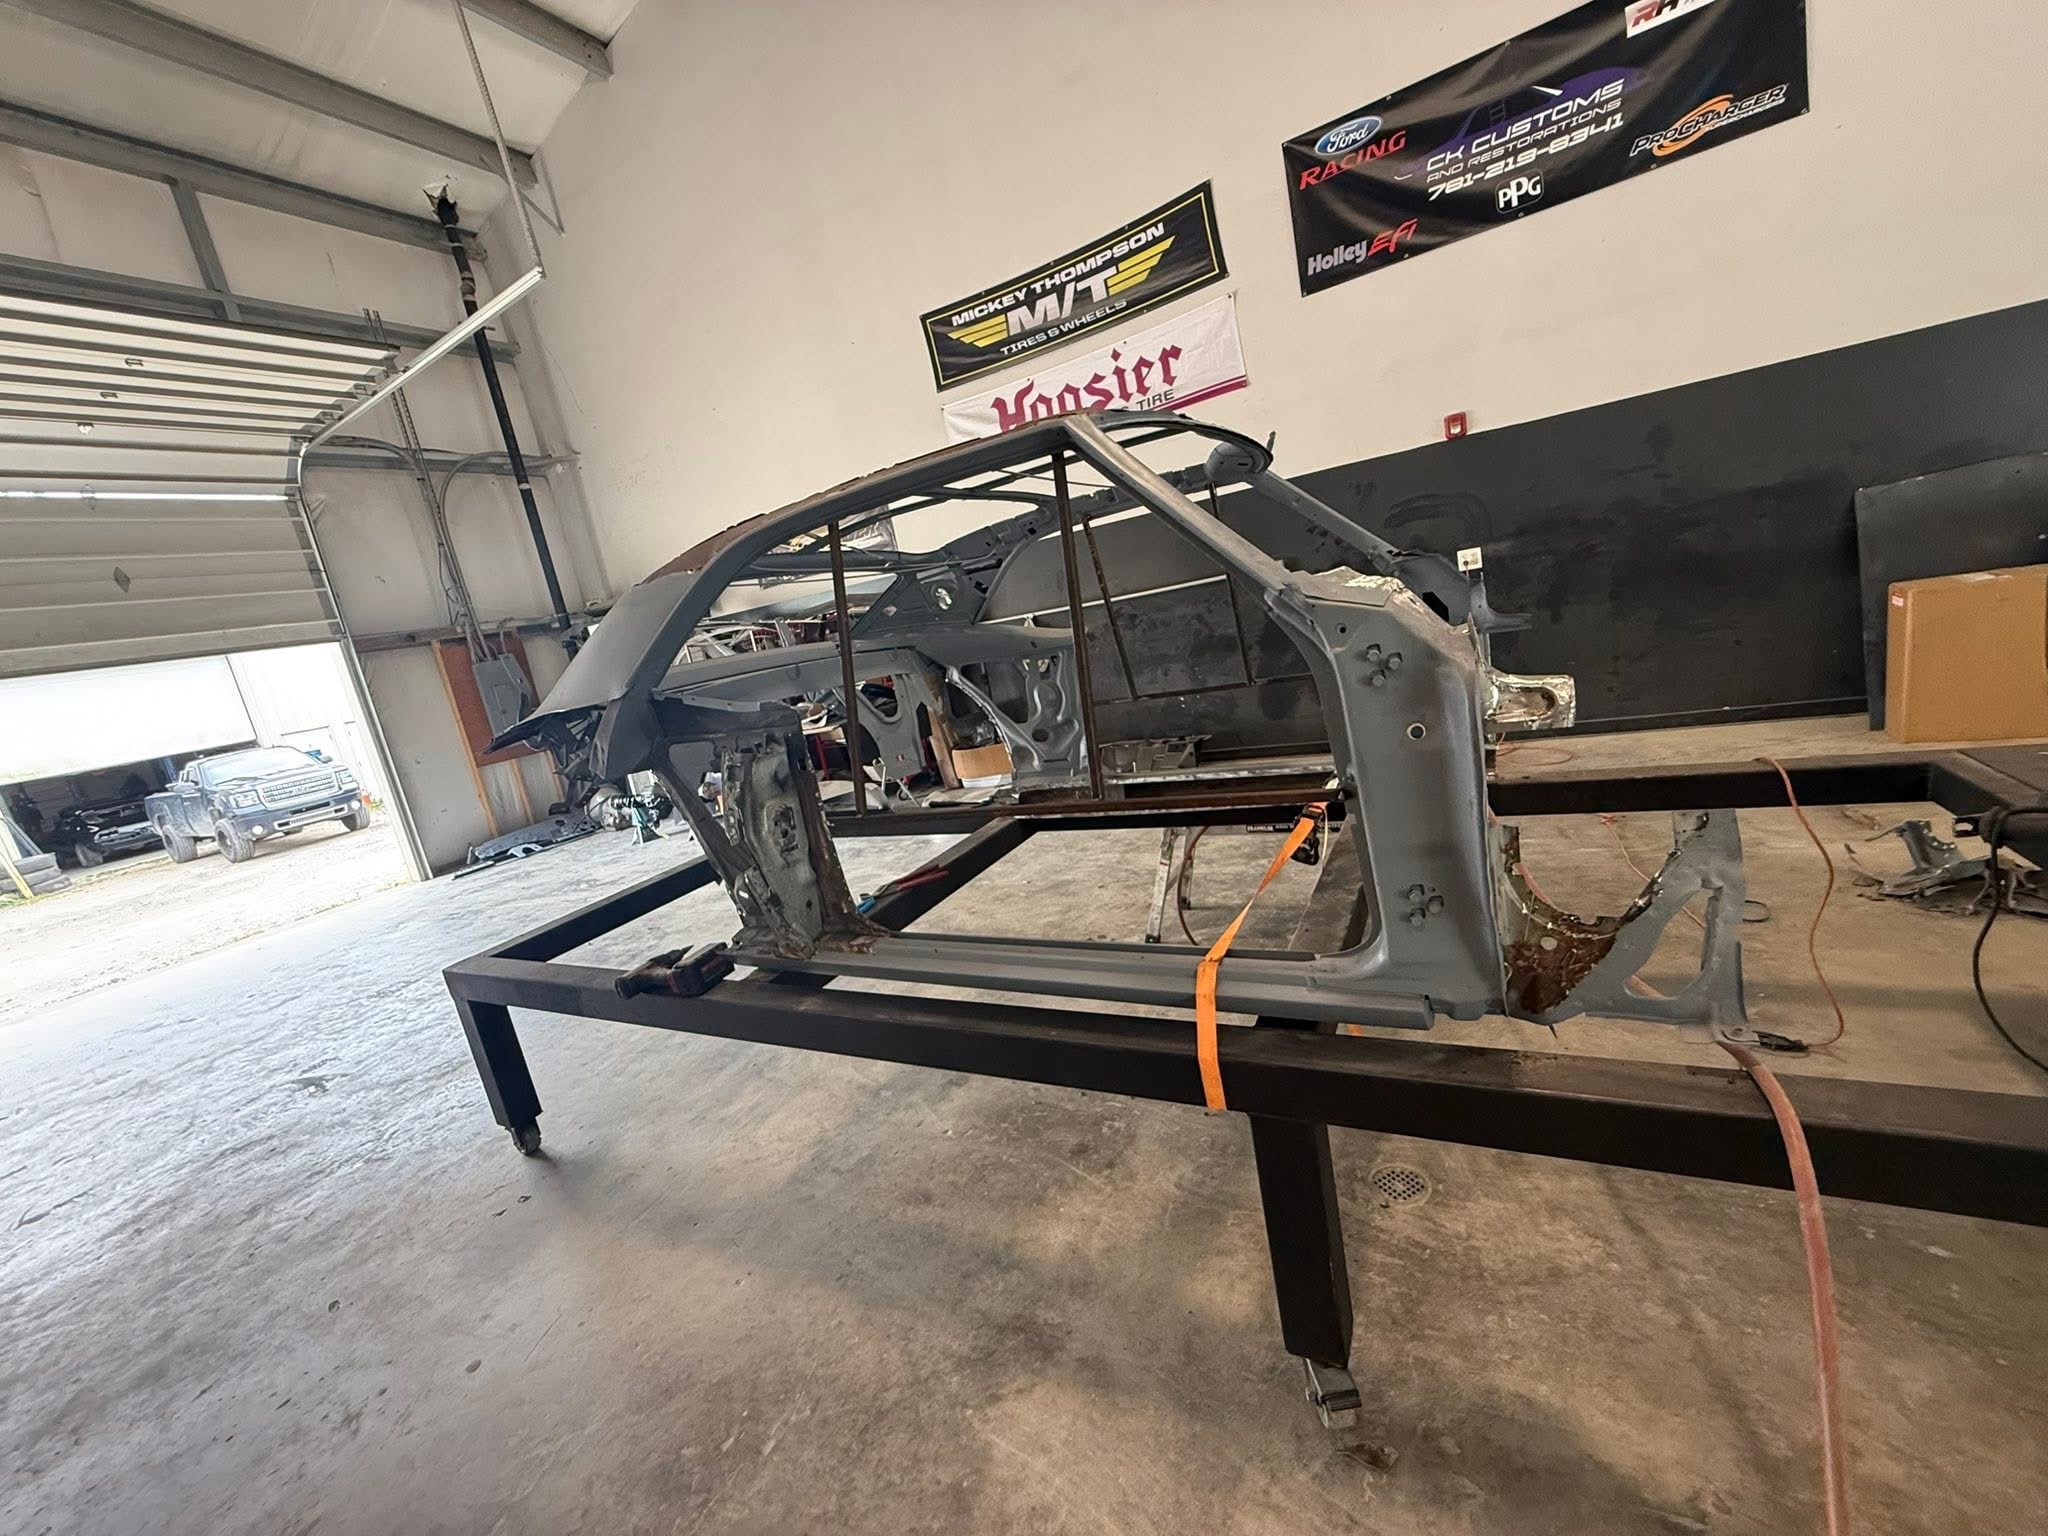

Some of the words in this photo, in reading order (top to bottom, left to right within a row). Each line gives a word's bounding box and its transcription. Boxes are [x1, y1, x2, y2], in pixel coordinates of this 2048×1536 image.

[1327, 122, 1370, 153] Ford
[1426, 145, 1465, 172] CK
[1471, 78, 1625, 154] CUSTOMS
[1426, 163, 1464, 184] AND
[1467, 97, 1622, 168] RESTORATIONS
[1428, 112, 1625, 201] 781-219-8341
[1629, 83, 1789, 157] PROCHARGER
[1299, 130, 1406, 190] RACING
[1498, 175, 1542, 209] PPG
[951, 287, 1028, 327] MICKEY
[1030, 221, 1166, 295] THOMPSON
[1307, 240, 1367, 276] Holley
[1367, 217, 1419, 257] EFI
[1000, 332, 1048, 356] TIRES
[1060, 300, 1128, 332] WHEELS
[1006, 265, 1119, 338] M/T
[990, 344, 1183, 433] Hoosier
[1136, 388, 1175, 411] TIRE
